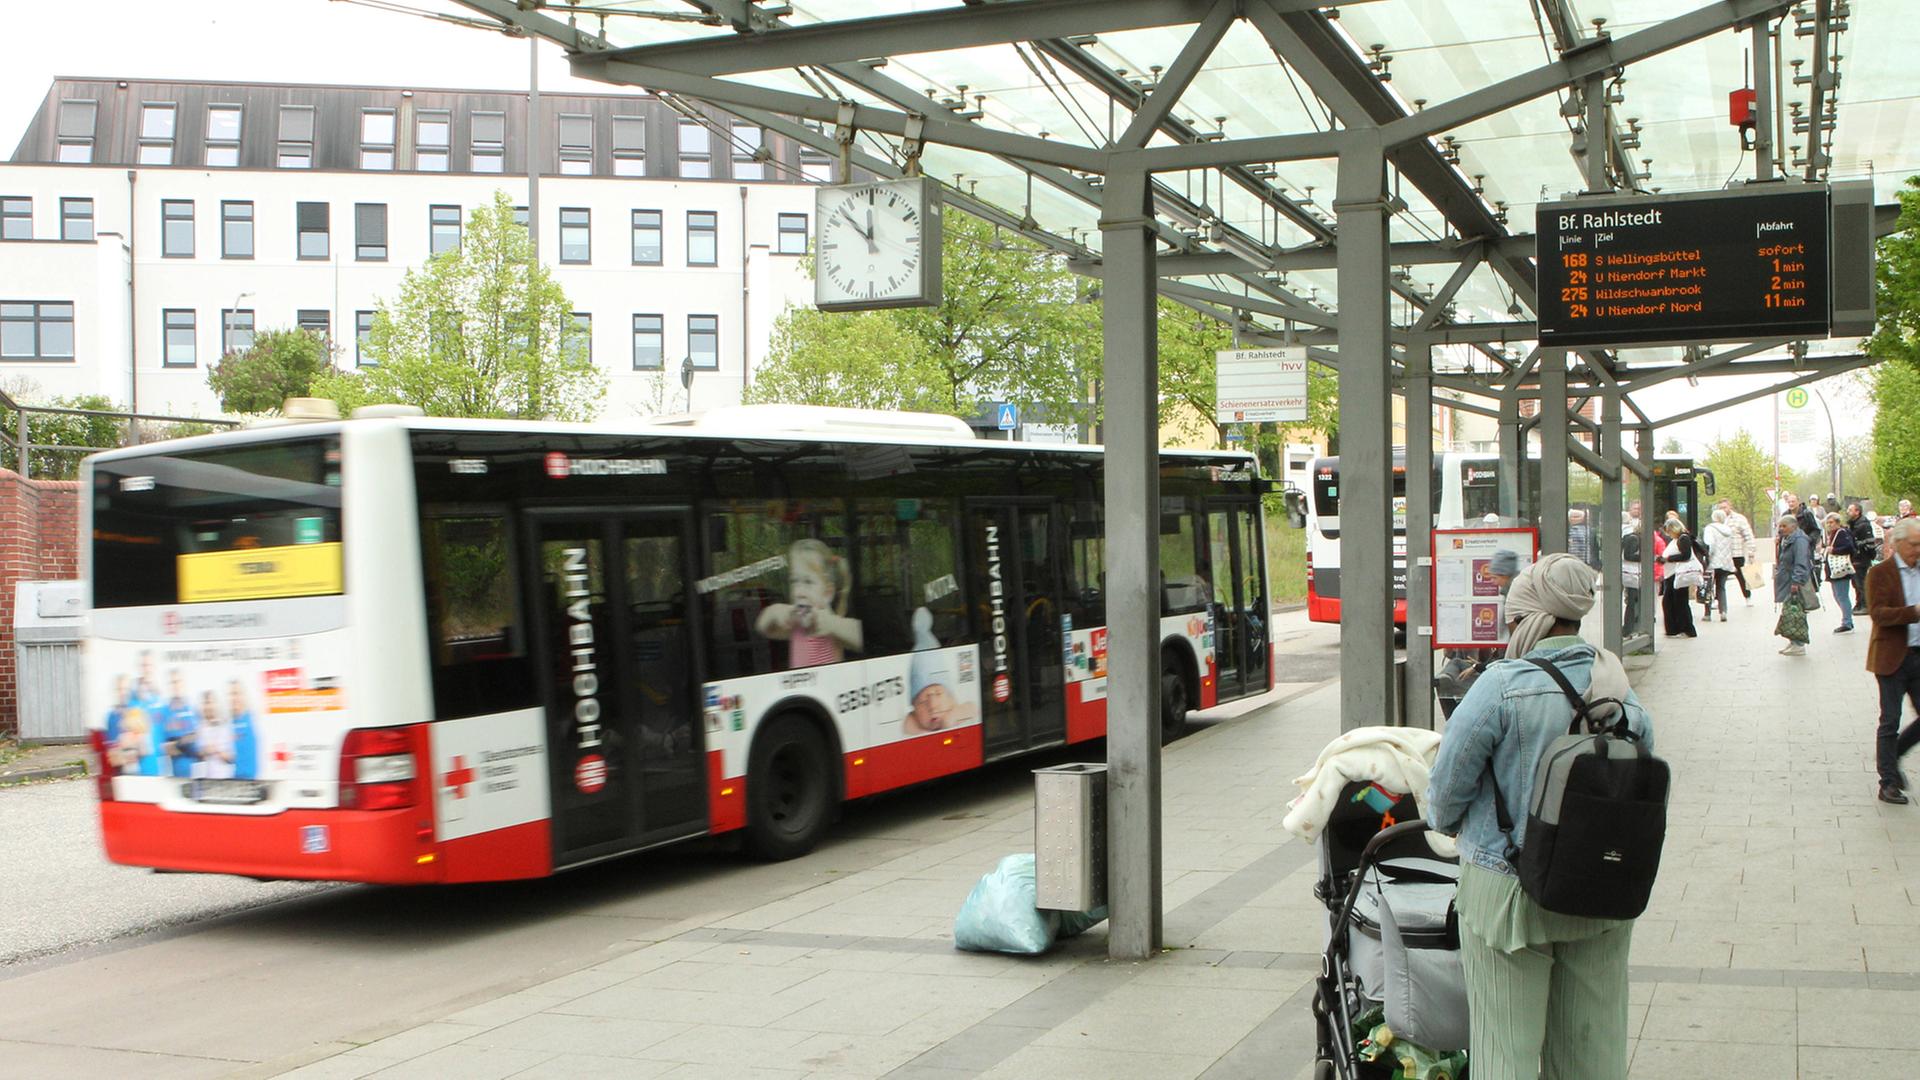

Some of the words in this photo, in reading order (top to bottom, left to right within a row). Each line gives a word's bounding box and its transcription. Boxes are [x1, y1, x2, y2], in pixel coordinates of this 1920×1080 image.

[1559, 215, 1579, 231] Bf.
[1583, 209, 1662, 229] Rahlstedt
[1562, 234, 1583, 244] Linie
[1597, 232, 1614, 243] Ziel
[1759, 220, 1794, 232] Abfahrt
[1562, 253, 1588, 268] 168
[1595, 255, 1604, 266] S
[1608, 250, 1701, 266] Wellingsbüttel
[1758, 243, 1805, 257] sofort
[1570, 271, 1588, 285] 24
[1595, 273, 1604, 283] U
[1608, 268, 1666, 282] Niendorf
[1670, 265, 1707, 279] Markt
[1773, 259, 1781, 273] 1
[1783, 261, 1805, 272] min
[1561, 288, 1588, 301] 275
[1595, 284, 1702, 300] Wildschwanbrook
[1771, 276, 1781, 290] 2
[1783, 279, 1805, 290] min
[1570, 305, 1588, 318] 24
[1595, 306, 1604, 317] U
[1608, 303, 1666, 316] Niendorf
[1670, 301, 1702, 312] Nord
[1764, 294, 1781, 308] 11
[1783, 296, 1805, 307] min
[1248, 351, 1286, 359] Rahlstedt
[1281, 362, 1302, 370] hvv
[1220, 399, 1302, 409] Schienenersatzverkehr
[986, 526, 1008, 671] HOCHBAHN
[562, 548, 602, 748] HOCHBAHN
